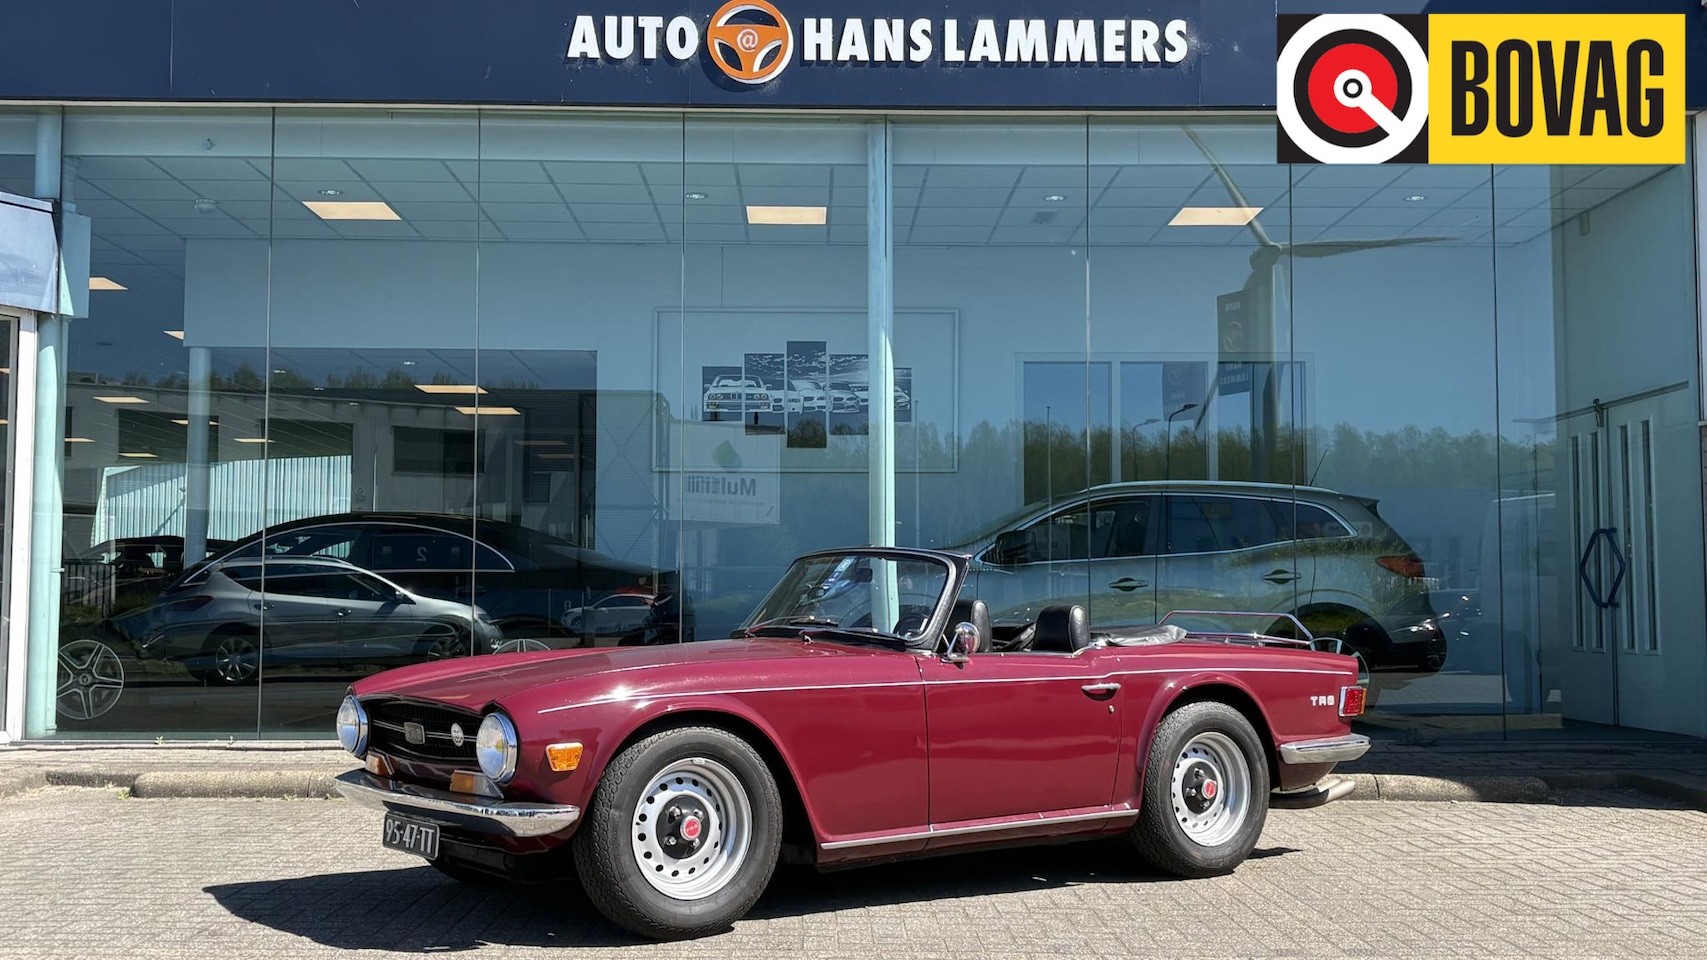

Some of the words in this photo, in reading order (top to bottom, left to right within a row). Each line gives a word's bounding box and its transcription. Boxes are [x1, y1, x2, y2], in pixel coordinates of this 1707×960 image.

[567, 15, 699, 60] AUTO
[803, 18, 933, 63] HANS
[944, 19, 1188, 63] LAMMERS
[386, 819, 435, 853] 95-47-TT
